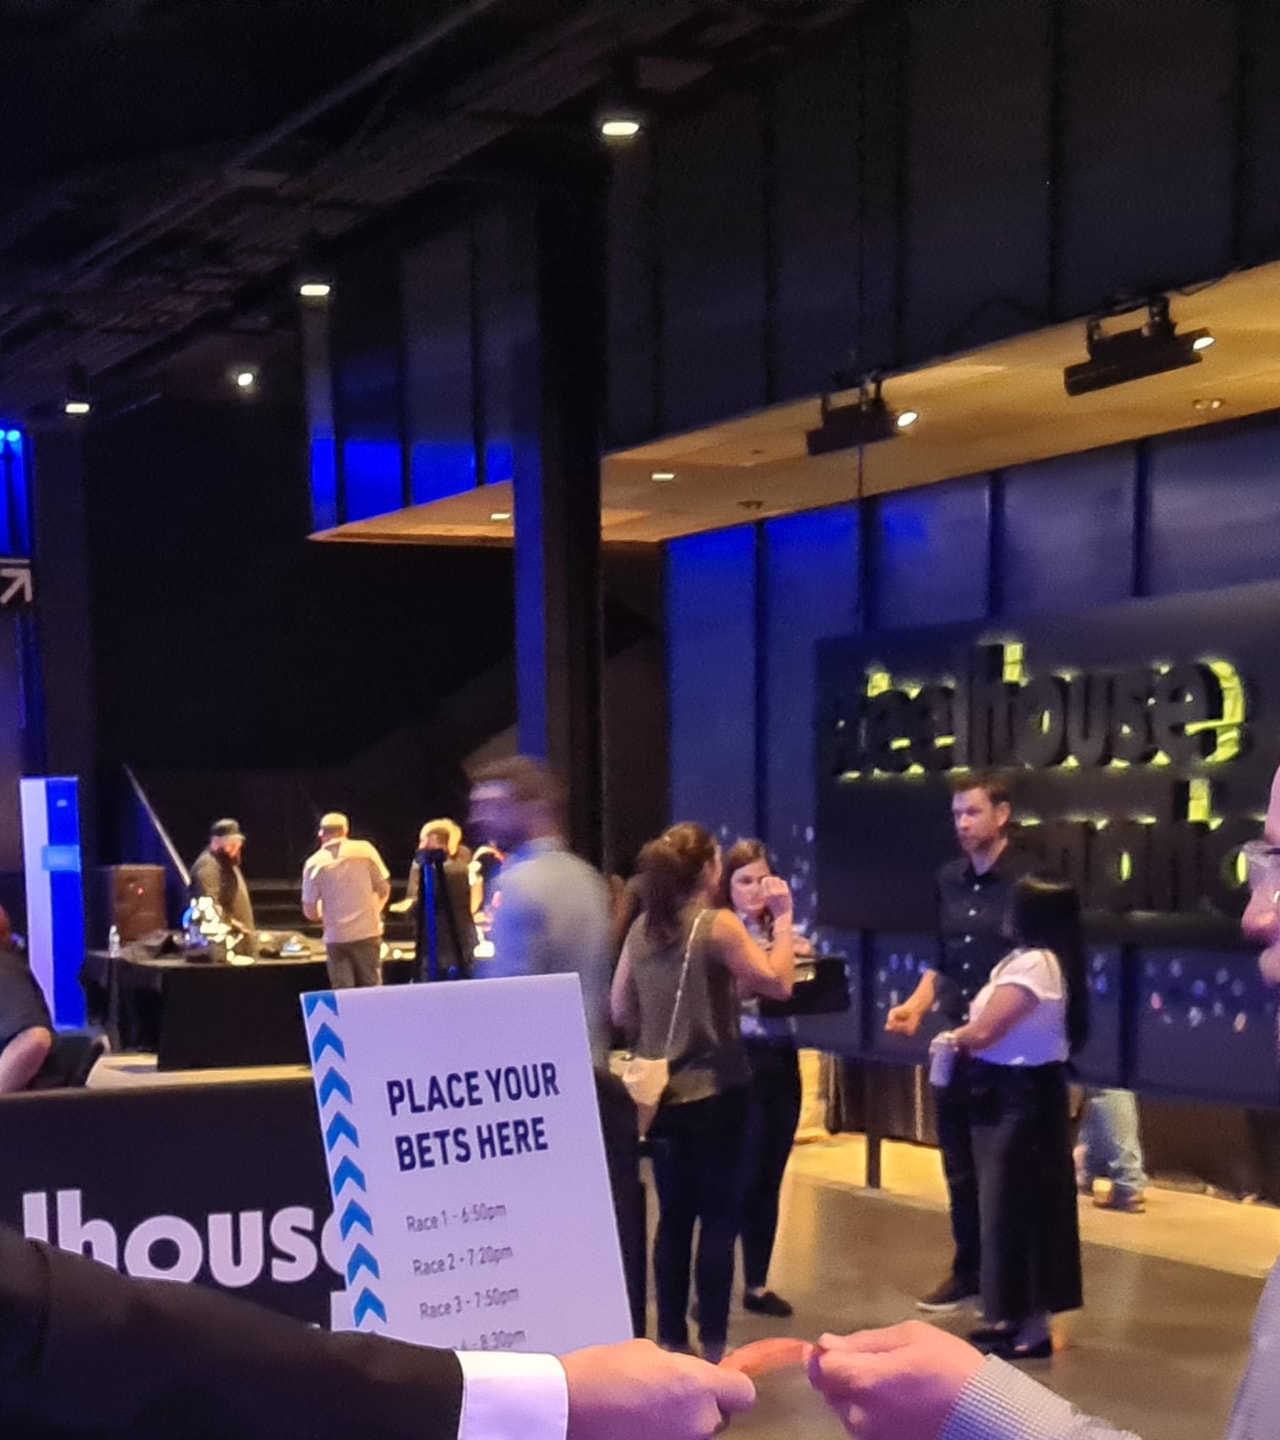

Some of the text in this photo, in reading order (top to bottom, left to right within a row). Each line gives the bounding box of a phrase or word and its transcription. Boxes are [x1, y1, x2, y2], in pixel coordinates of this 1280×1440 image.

[387, 1062, 560, 1116] PLACE YOUR
[395, 1117, 548, 1171] BETS HERE
[406, 1215, 438, 1232] Race
[441, 1210, 448, 1225] 1
[412, 1259, 445, 1276] Race
[448, 1253, 455, 1270] 2
[420, 1302, 451, 1319] Race
[455, 1295, 462, 1313] 3
